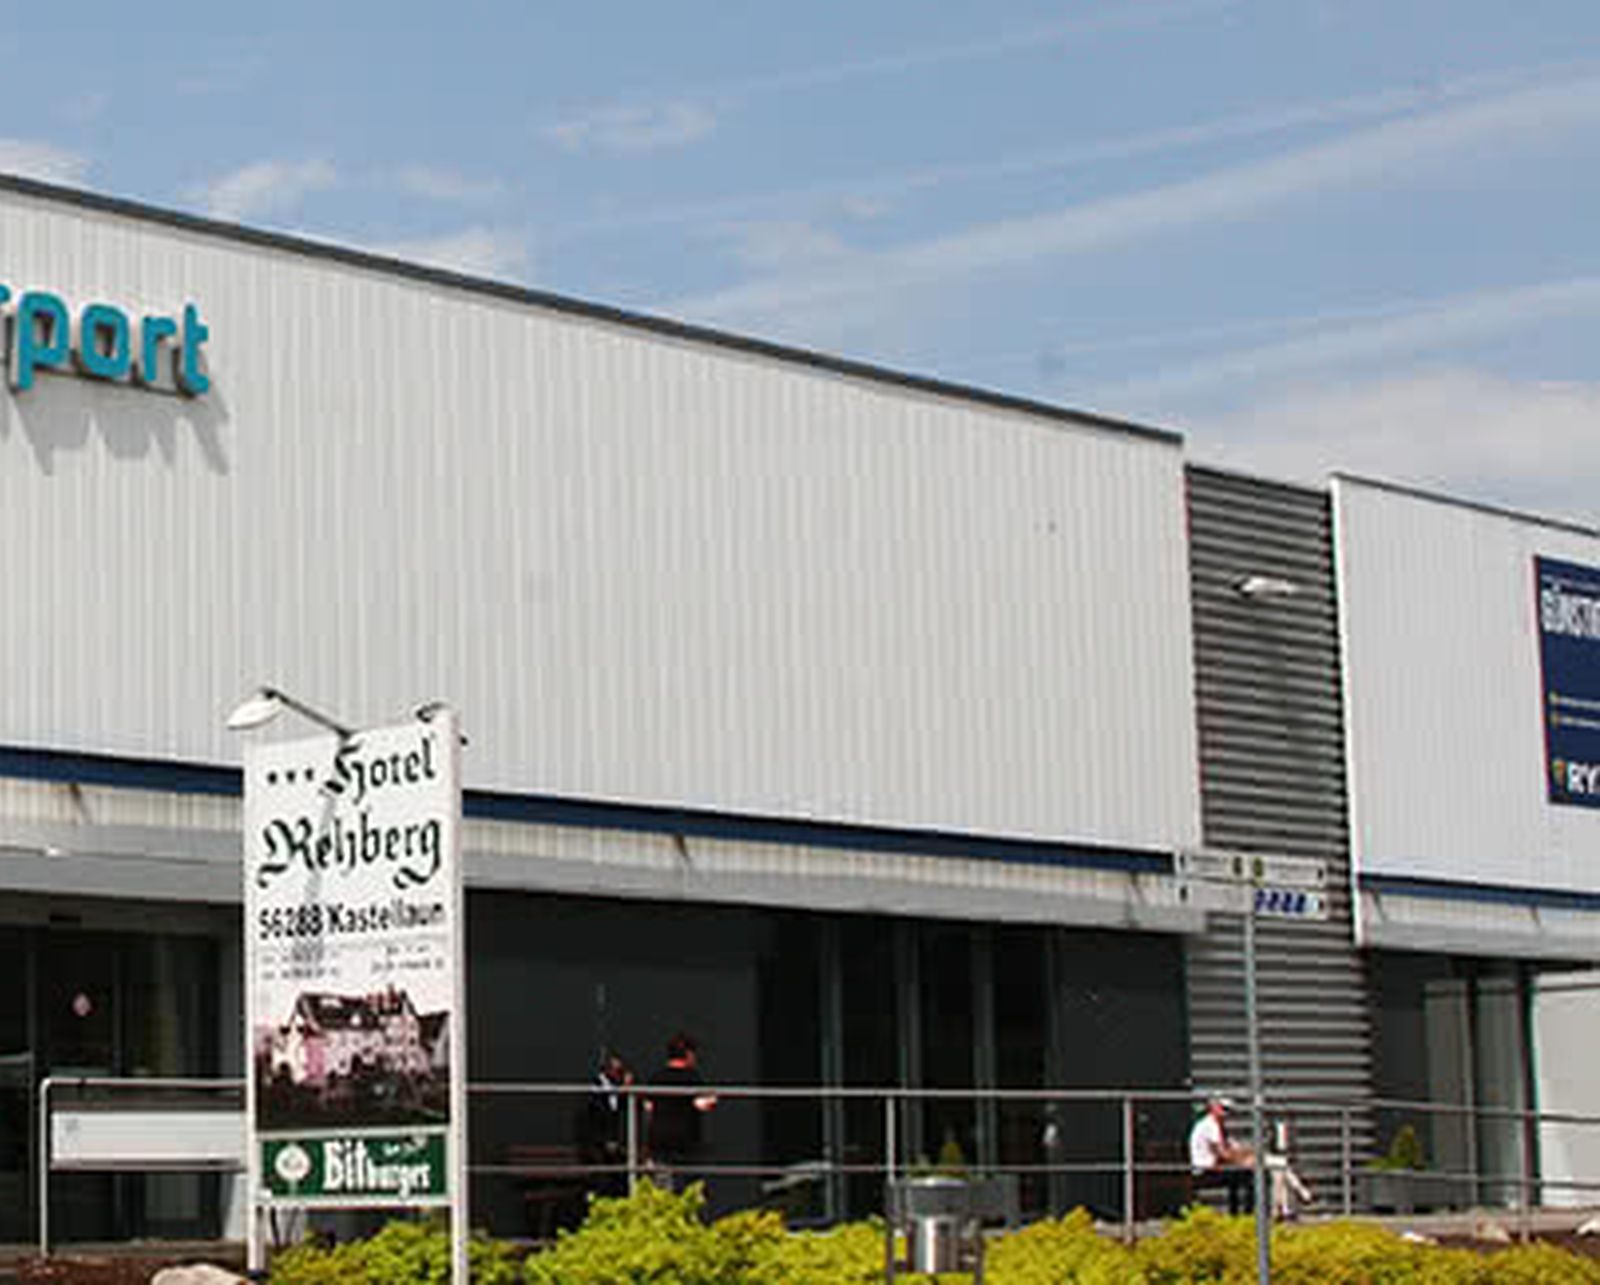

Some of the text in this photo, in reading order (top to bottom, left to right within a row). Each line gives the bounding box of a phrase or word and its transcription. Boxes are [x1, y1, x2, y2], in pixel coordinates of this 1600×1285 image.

[321, 739, 435, 805] Hotel
[1567, 761, 1600, 794] RY
[257, 811, 441, 889] Rehberg
[259, 905, 323, 939] 56288
